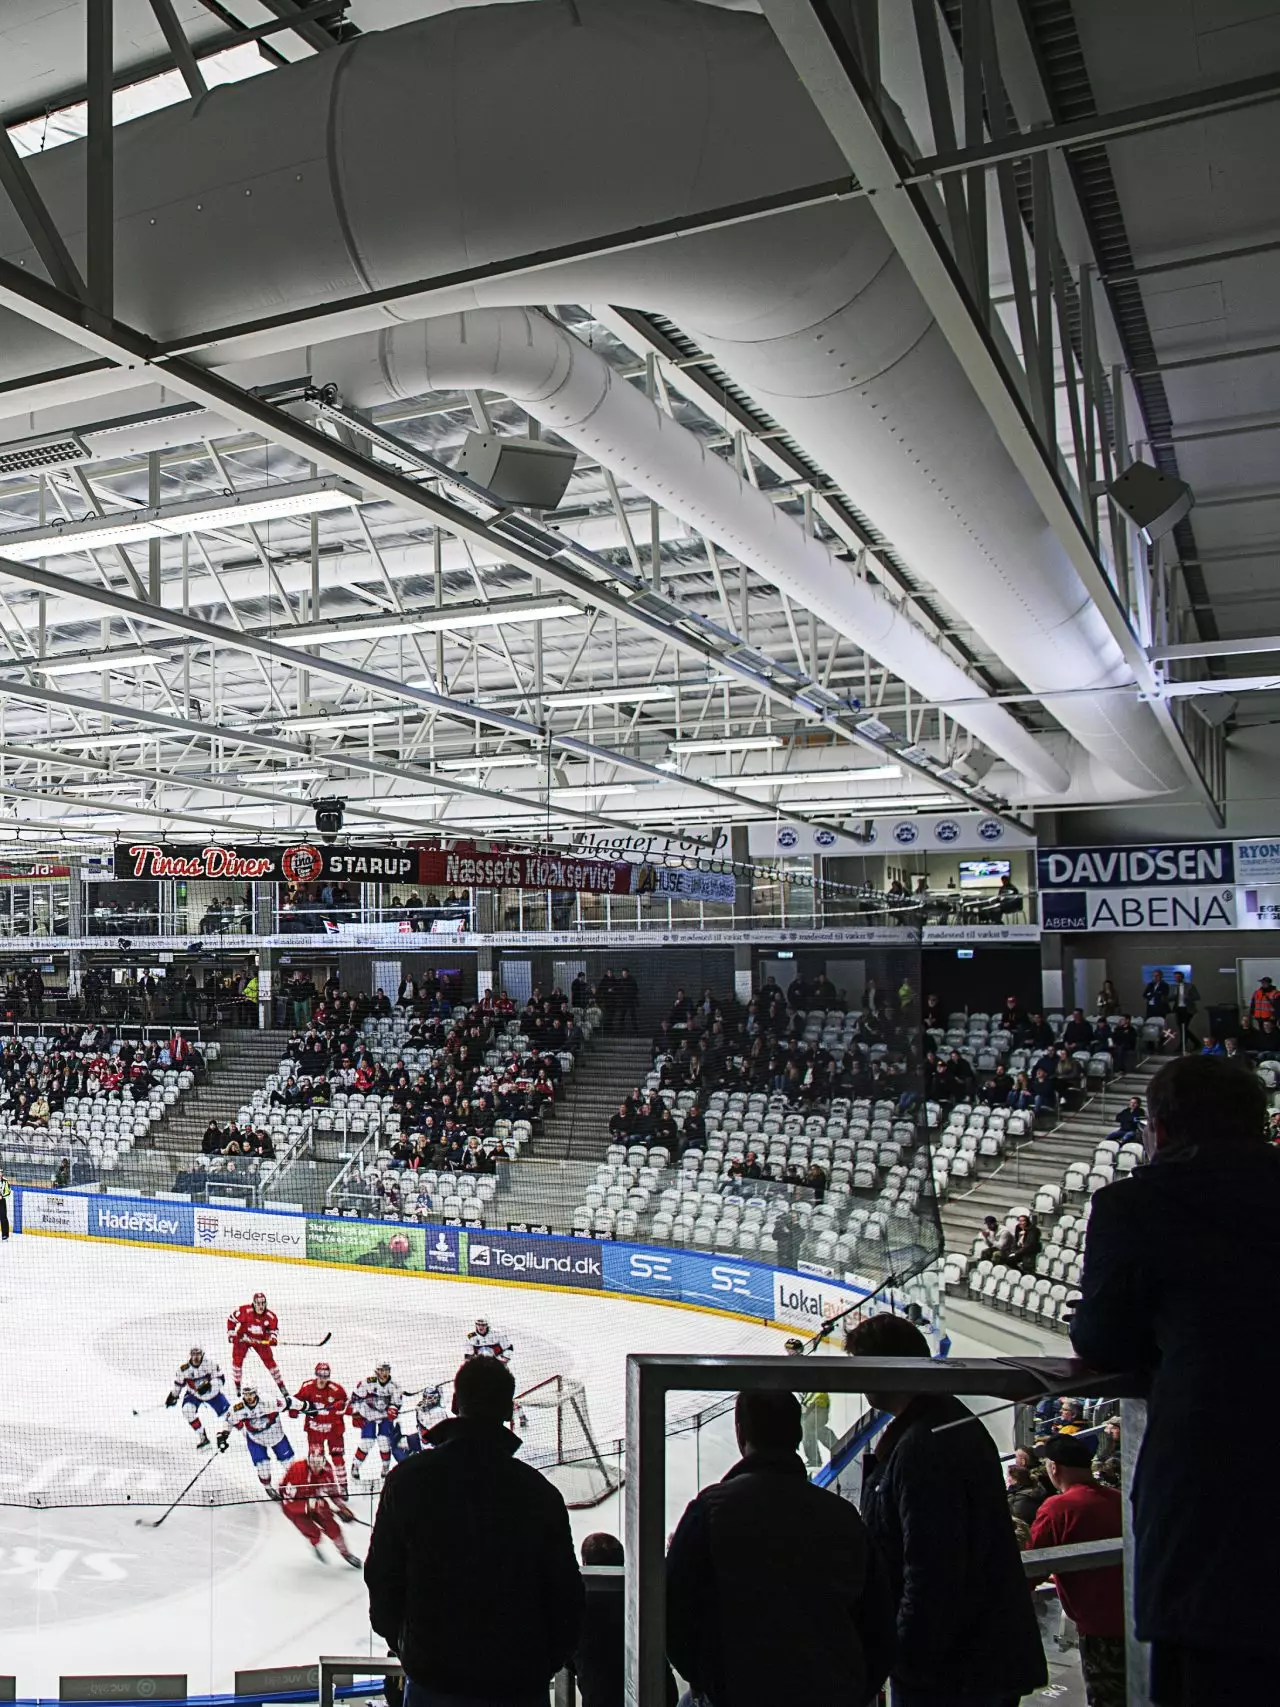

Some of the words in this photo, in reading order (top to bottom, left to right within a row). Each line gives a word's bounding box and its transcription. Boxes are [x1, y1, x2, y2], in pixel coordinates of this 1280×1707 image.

[129, 845, 204, 877] Tinas
[202, 846, 275, 878] Diner
[330, 856, 411, 876] STARUP
[446, 855, 521, 885] Næssets
[525, 858, 617, 892] Kloakservice
[1047, 848, 1224, 884] DAVIDSEN
[1044, 917, 1086, 929] ABENA
[1090, 895, 1232, 928] ABENA
[98, 1208, 179, 1235] Haderslev
[223, 1226, 301, 1246] Haderslev
[491, 1248, 602, 1276] Tegllund.dk
[630, 1253, 672, 1281] SE
[711, 1266, 751, 1296] SE
